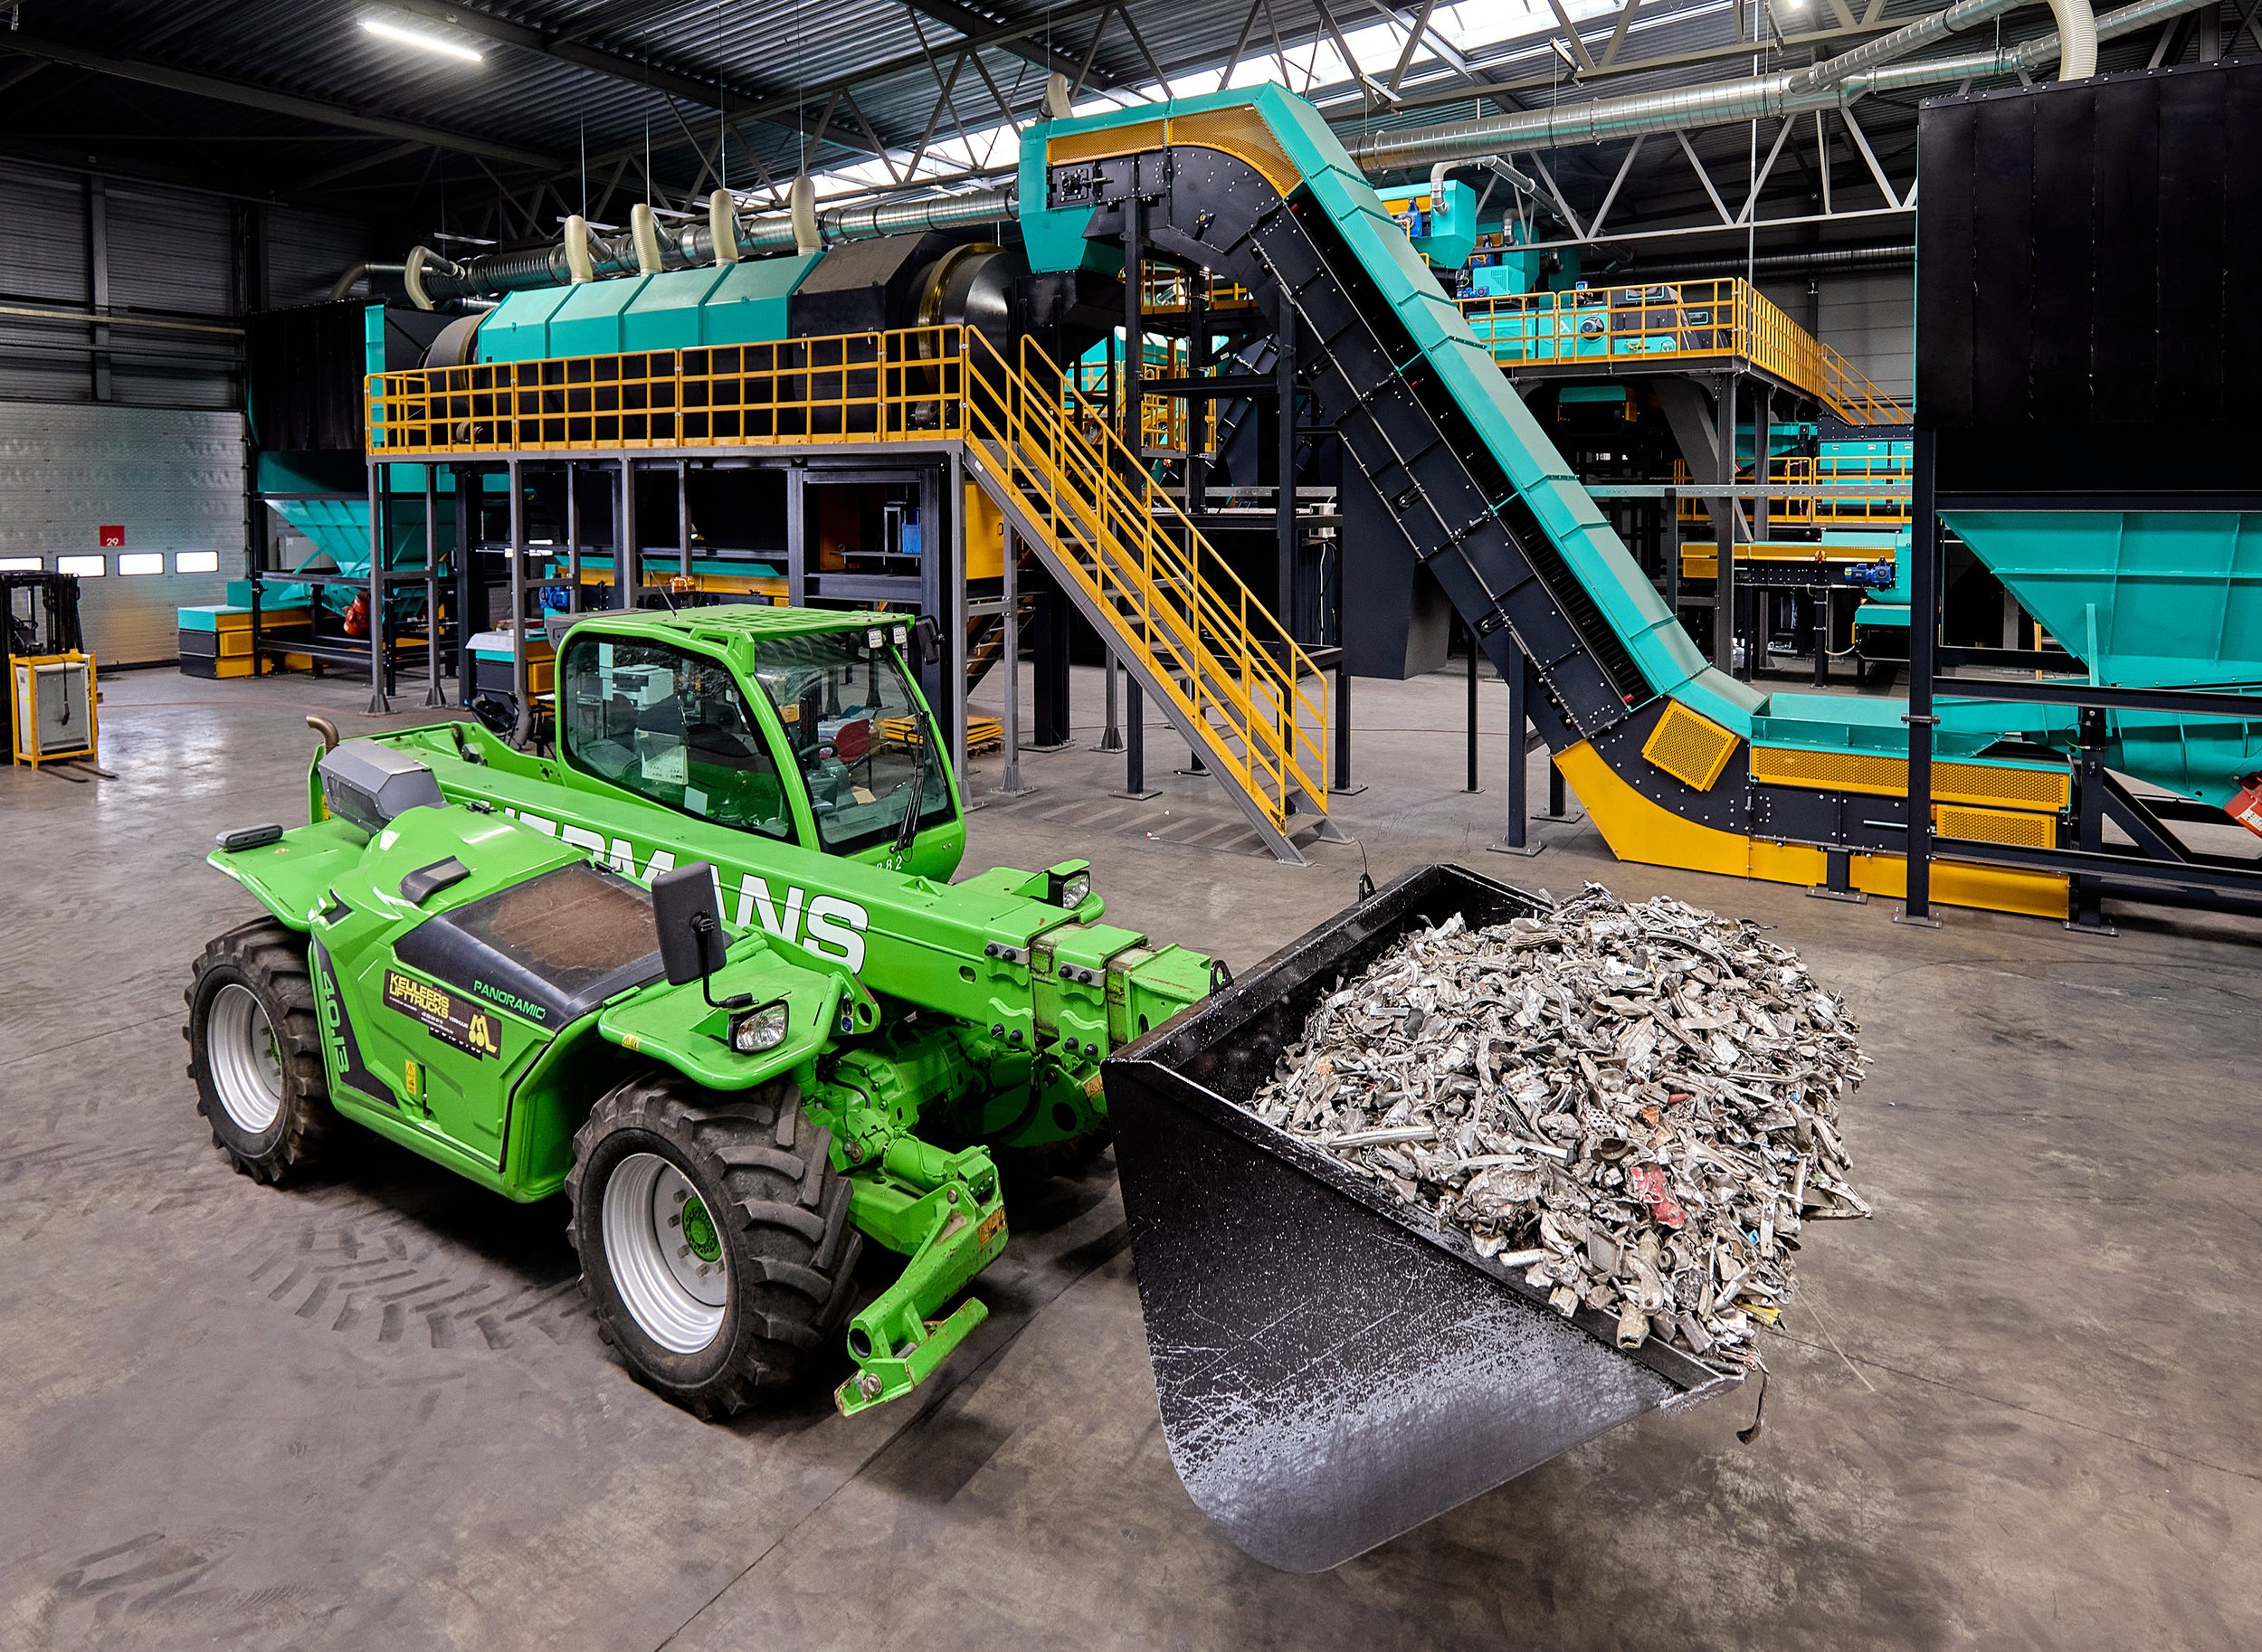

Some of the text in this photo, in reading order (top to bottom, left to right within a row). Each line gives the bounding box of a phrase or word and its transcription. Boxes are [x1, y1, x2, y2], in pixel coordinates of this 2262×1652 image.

[106, 536, 119, 546] 29
[389, 983, 449, 1019] LIFTTRUCKS
[390, 973, 450, 1009] KEULEERS
[473, 980, 546, 1021] PANORAMIC
